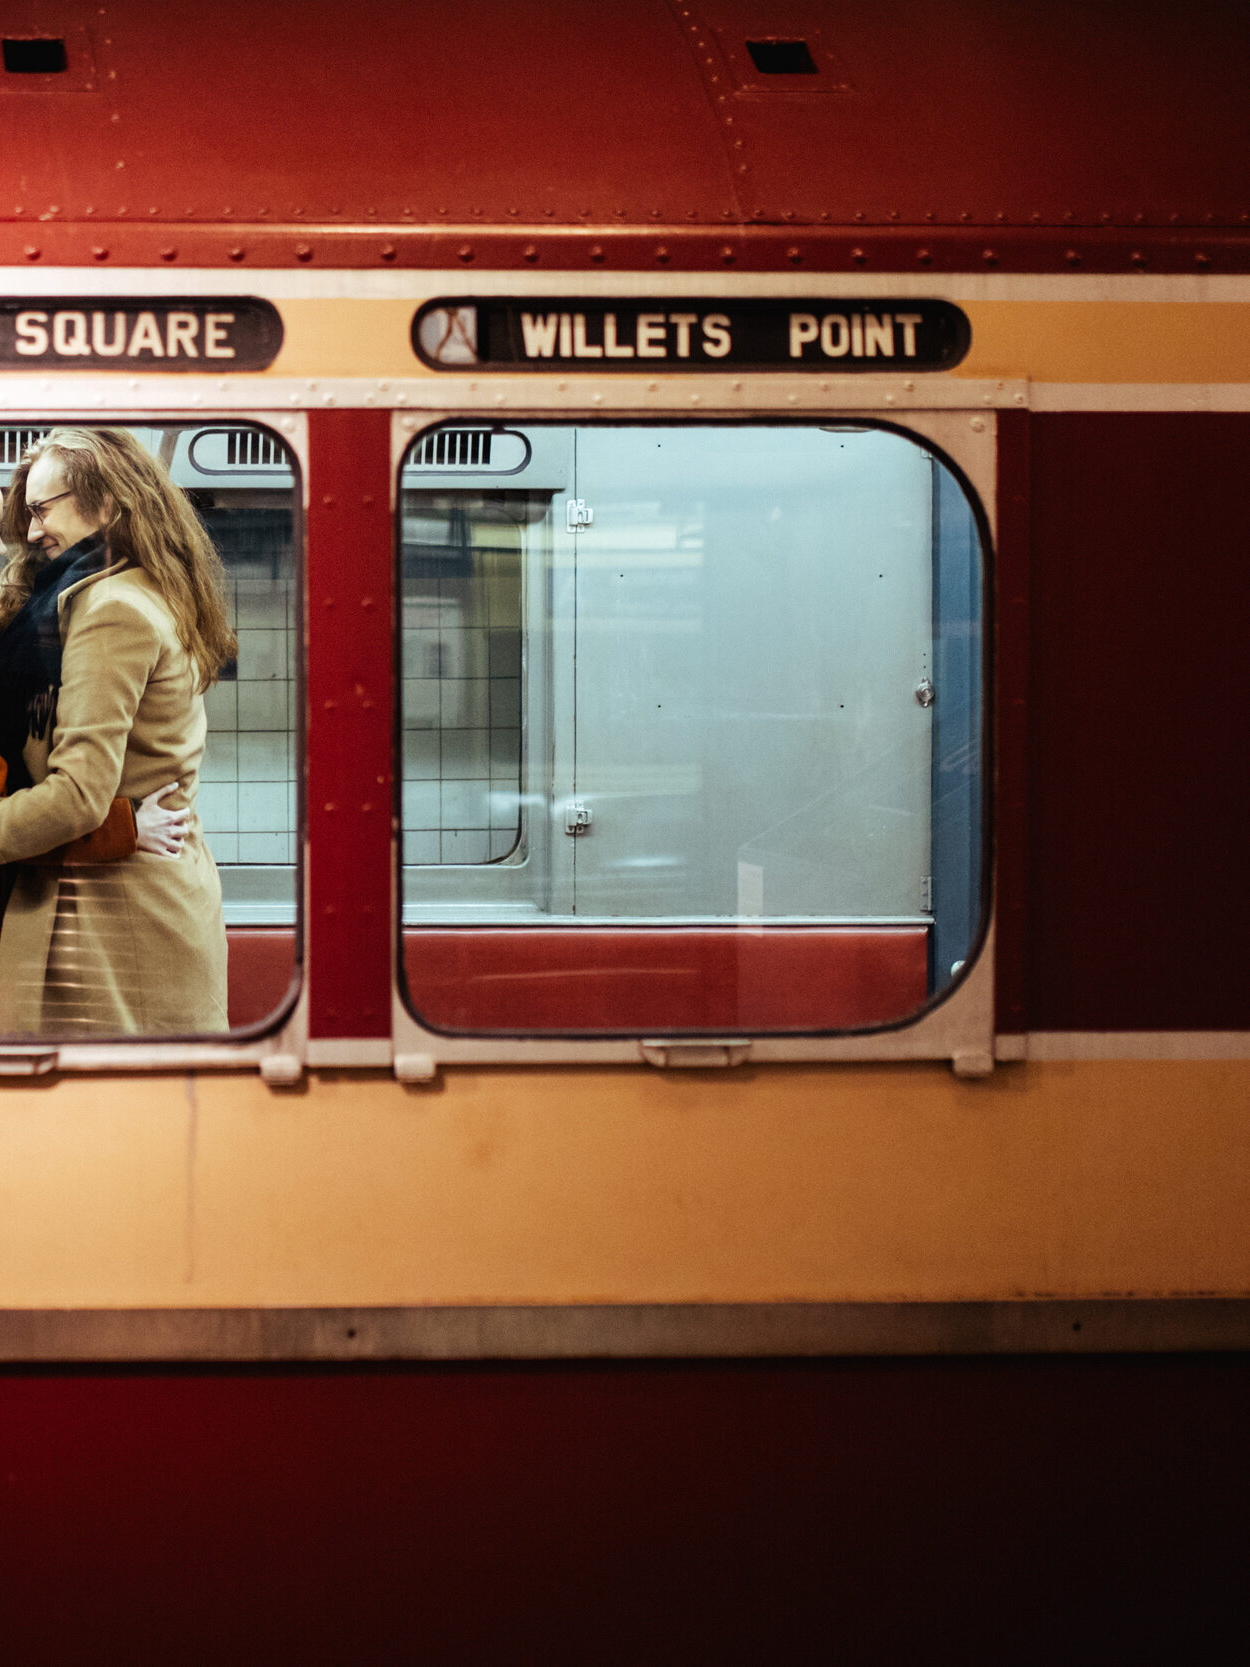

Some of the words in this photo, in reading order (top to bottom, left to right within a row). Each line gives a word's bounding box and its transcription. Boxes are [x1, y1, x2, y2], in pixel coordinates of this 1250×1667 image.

[15, 312, 235, 358] SQUARE
[521, 314, 732, 358] WILLETS
[789, 314, 921, 358] POINT
